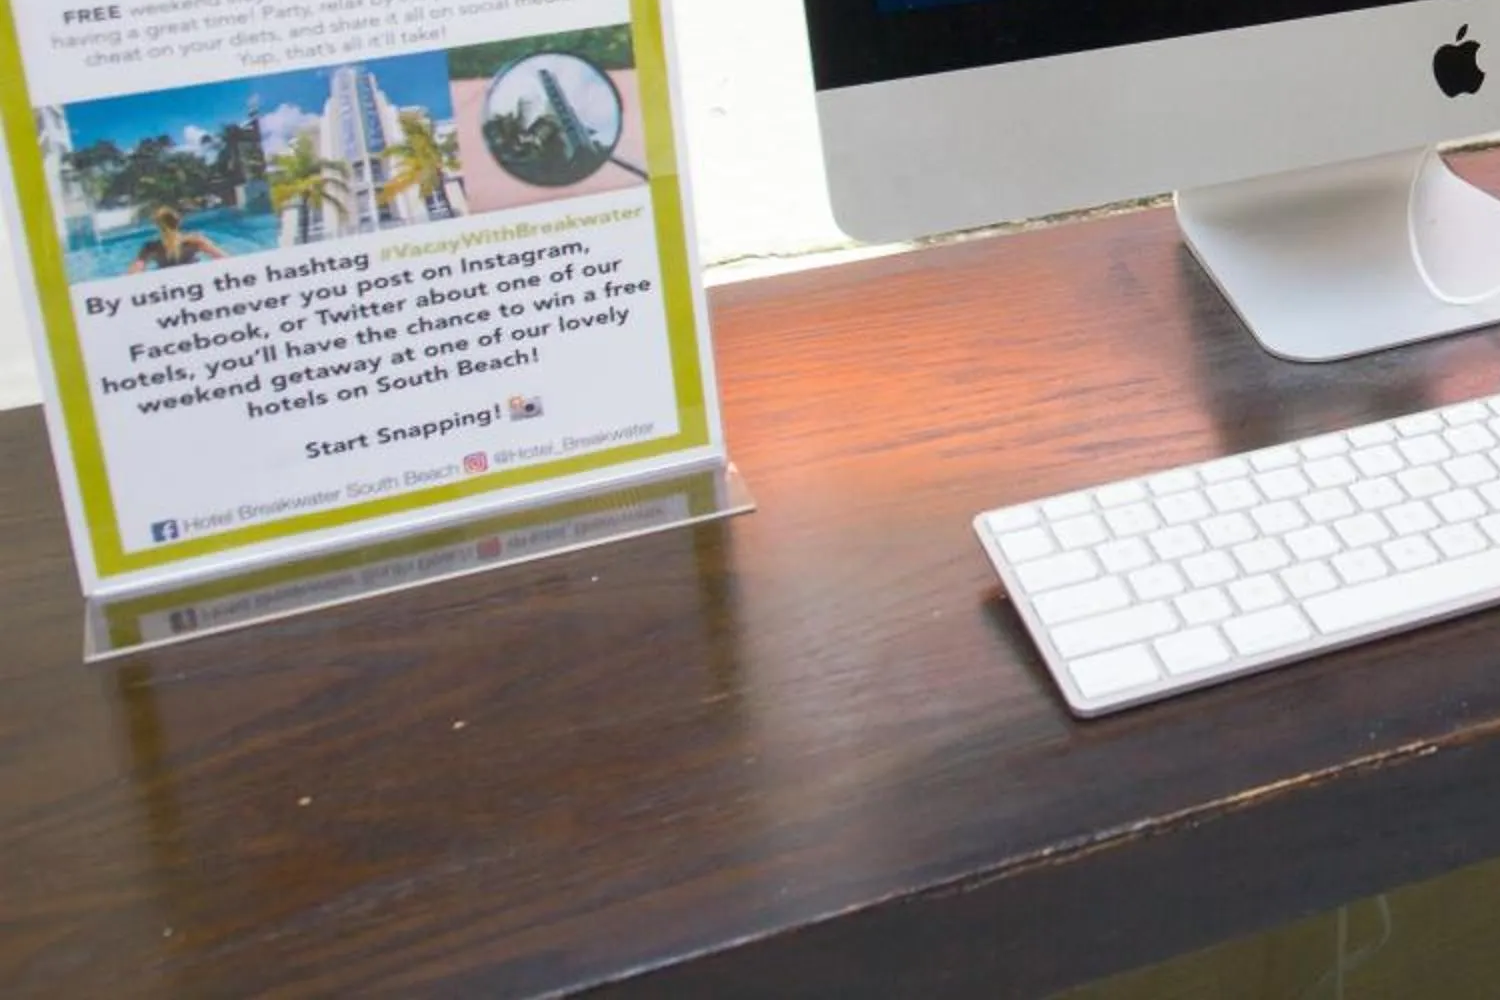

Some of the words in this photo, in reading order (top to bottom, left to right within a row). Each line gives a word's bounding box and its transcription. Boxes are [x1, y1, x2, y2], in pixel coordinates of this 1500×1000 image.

[51, 27, 122, 51] having
[127, 26, 140, 40] a
[146, 16, 199, 41] great
[203, 9, 254, 29] time!
[63, 4, 122, 25] FREE
[84, 47, 142, 68] cheat
[147, 43, 174, 60] on
[178, 36, 224, 58] your
[289, 22, 324, 39] and
[331, 14, 381, 34] share
[386, 10, 397, 27] it
[404, 3, 424, 22] all
[429, 4, 453, 20] on
[285, 39, 336, 61] that's
[344, 33, 362, 52] all
[400, 25, 446, 45] take!
[85, 296, 122, 317] By
[131, 282, 204, 309] using
[213, 272, 257, 292] the
[266, 252, 369, 283] hashtag
[379, 205, 644, 262] #VacayWithBreakwater
[156, 292, 292, 330] whenever
[300, 285, 348, 309] you
[357, 271, 413, 297] post
[421, 263, 453, 282] on
[460, 239, 591, 275] Instagram,
[101, 364, 196, 395] hotels,
[205, 347, 278, 379] you'll
[286, 333, 347, 354] have
[355, 326, 398, 346] the
[406, 306, 492, 335] chance
[500, 302, 525, 319] to
[533, 291, 575, 313] win
[584, 288, 597, 304] a
[604, 277, 652, 299] free
[129, 321, 270, 363] Facebook,
[279, 316, 308, 334] or
[314, 297, 405, 327] Twitter
[416, 281, 489, 310] about
[496, 275, 542, 294] one
[549, 264, 573, 283] of
[581, 258, 623, 278] our
[137, 375, 262, 415] weekend
[271, 354, 383, 393] getaway
[391, 348, 417, 367] at
[424, 338, 469, 359] one
[477, 327, 502, 347] of
[511, 322, 552, 342] our
[559, 305, 630, 333] lovely
[247, 390, 328, 419] hotels
[337, 383, 369, 402] on
[376, 365, 449, 395] South
[458, 346, 540, 377] Beach!
[305, 433, 369, 459] Start
[376, 402, 502, 446] Snapping!
[494, 421, 655, 466] @Hotel_Breakwater
[183, 509, 233, 533] Hotel
[237, 489, 341, 521] Breakwater
[346, 473, 400, 499] South
[404, 461, 460, 487] Beach
